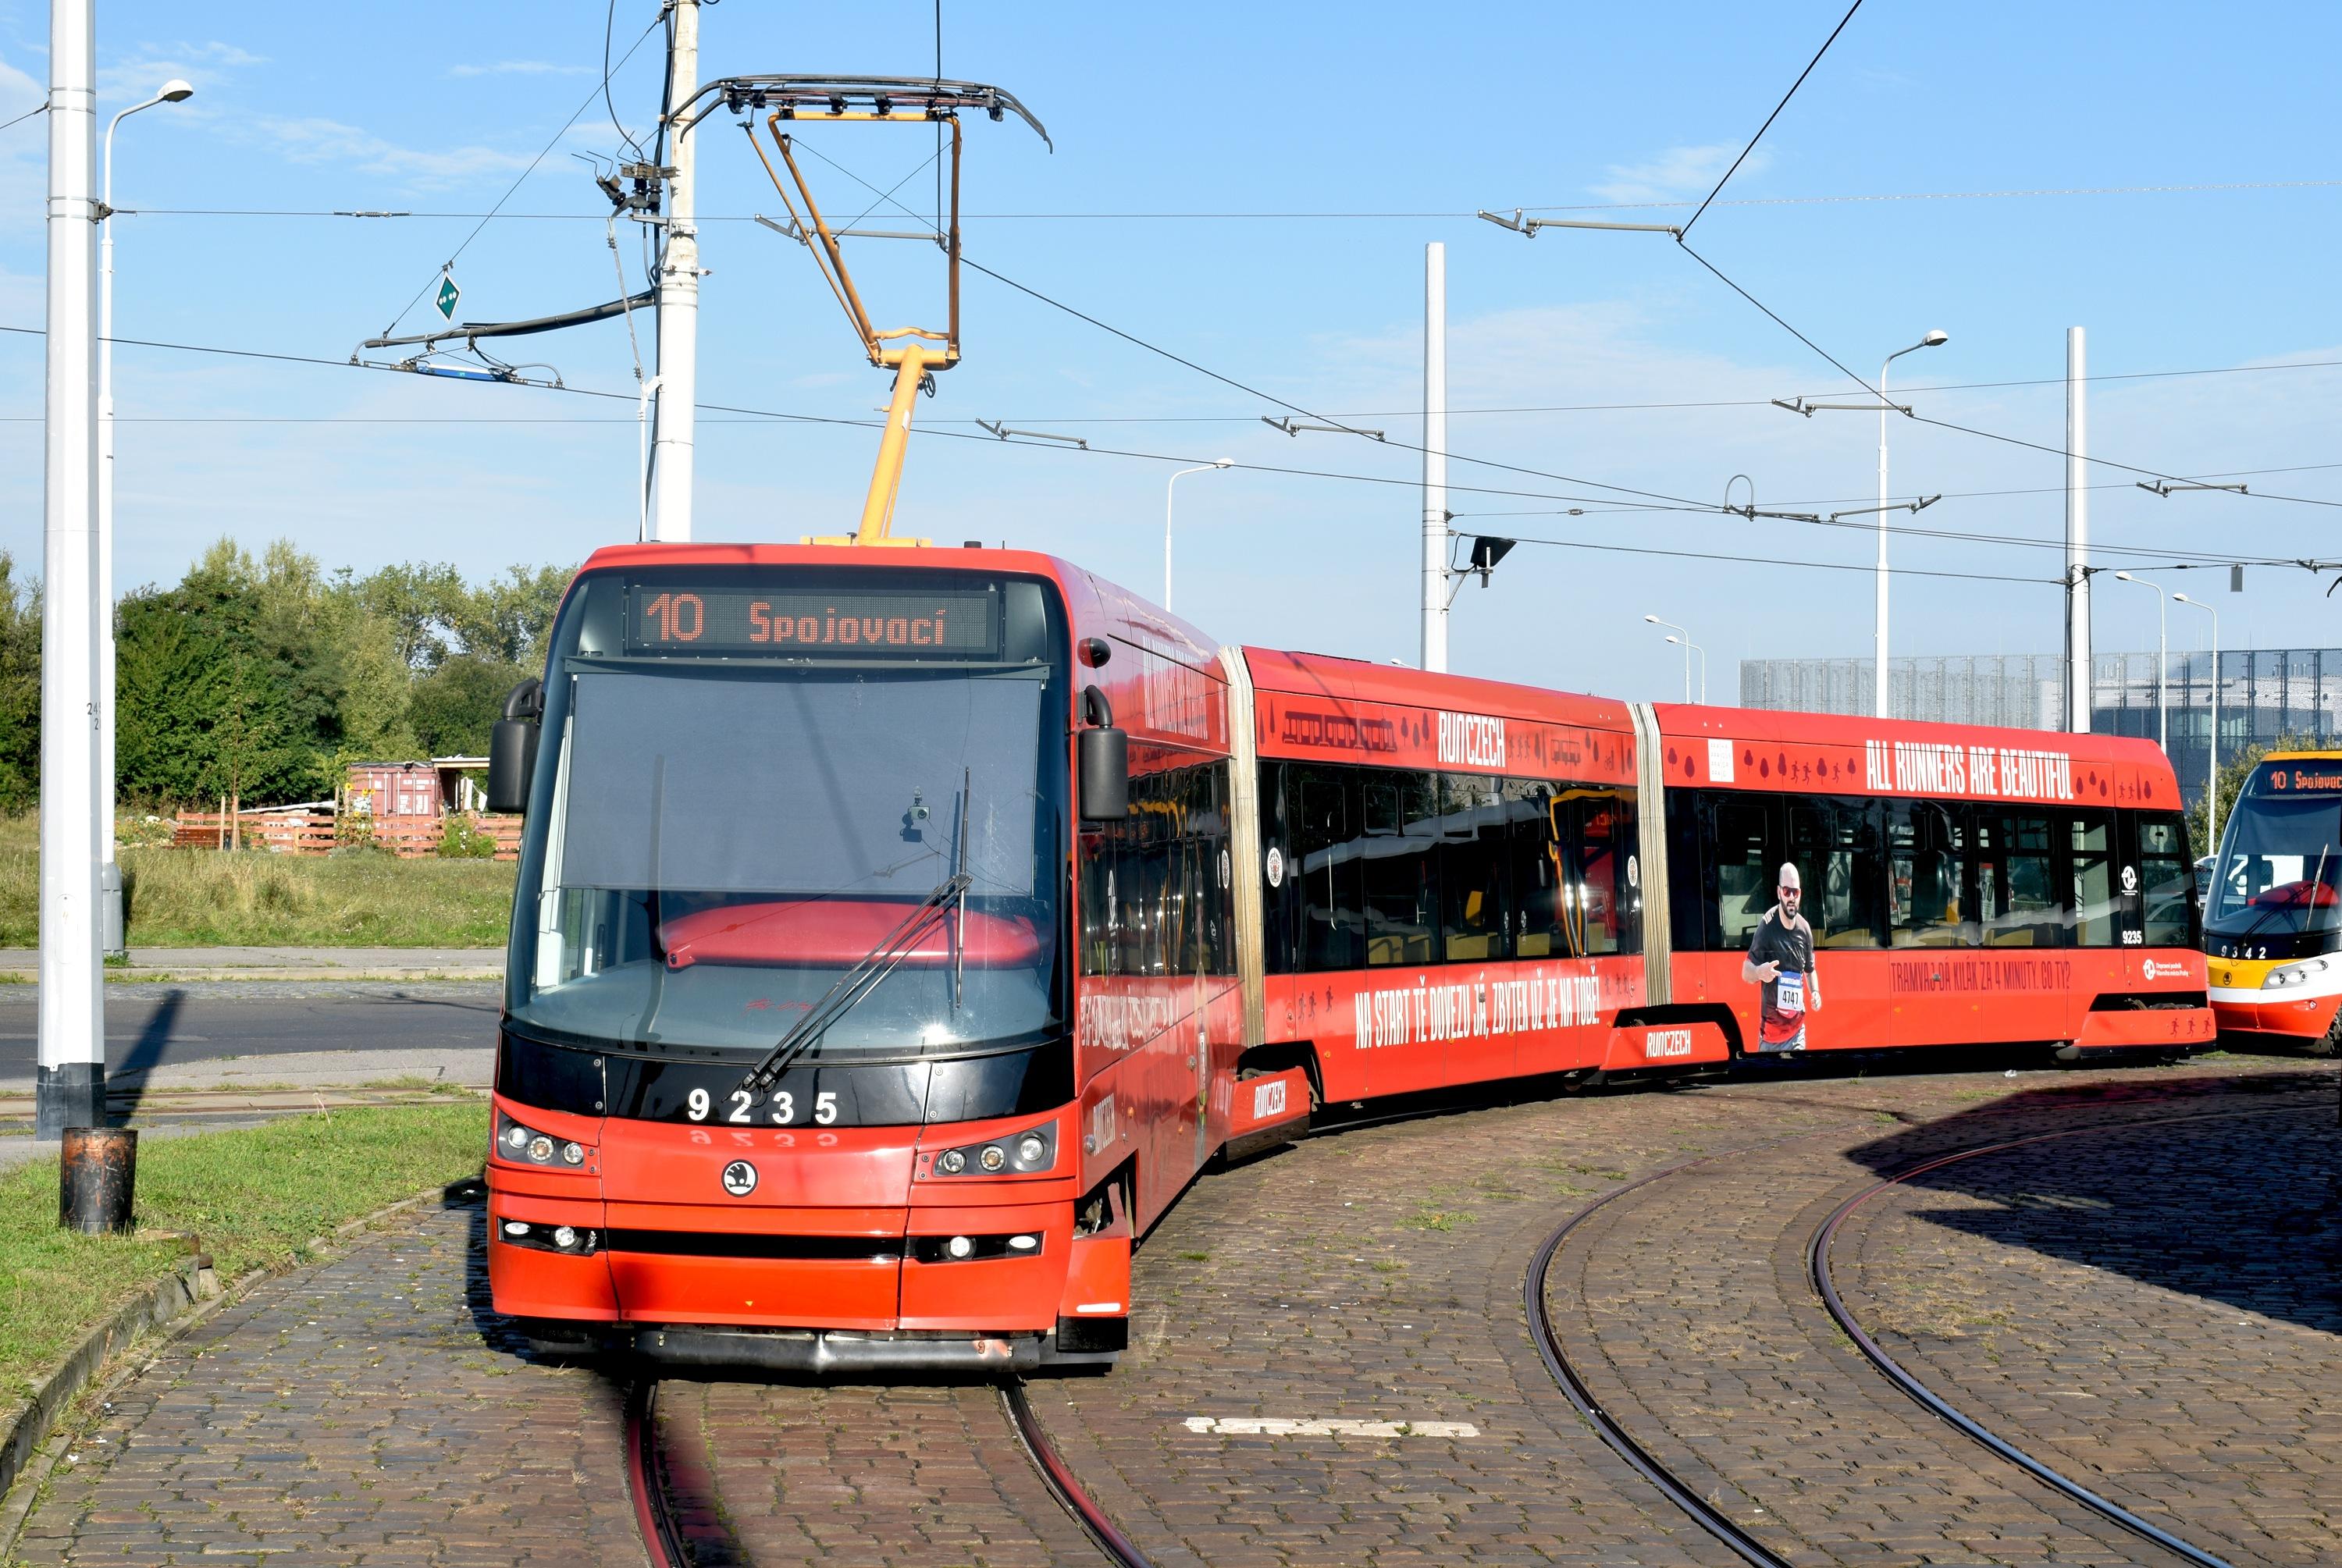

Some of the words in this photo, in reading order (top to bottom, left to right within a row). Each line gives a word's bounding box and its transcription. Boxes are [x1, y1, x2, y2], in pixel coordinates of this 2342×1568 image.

[647, 593, 703, 641] 10
[749, 602, 946, 645] Spojovací
[1439, 711, 1505, 768] RUNCZECH
[1866, 740, 1892, 791] ALL
[1895, 741, 1966, 794] RUNNERS
[1969, 746, 1998, 795] ARE
[2000, 748, 2073, 800] BEAUTIFUL
[2271, 771, 2287, 789] 10
[2123, 930, 2142, 944] 9235
[2221, 945, 2266, 959] 9342
[1891, 962, 1936, 992] TRAMVAJ
[1938, 955, 1952, 992] DÁ
[1953, 955, 1978, 992] KILÁK
[1980, 961, 1992, 990] ZA
[1995, 961, 2001, 990] 4
[2041, 961, 2053, 990] CO
[2055, 961, 2071, 990] TY?
[1354, 992, 1372, 1049] NA
[1374, 989, 1411, 1047] START
[1413, 975, 1427, 1043] TĚ
[1429, 984, 1471, 1041] DOVEZU
[1492, 980, 1529, 1034] ZBYTEK
[1530, 968, 1543, 1030] UŽ
[1547, 979, 1557, 1029] JE
[1560, 976, 1572, 1027] NA
[1574, 965, 1600, 1026] TOBĚ!
[1782, 990, 1799, 1006] 4747
[1646, 1029, 1691, 1058] RUNCZECH
[688, 1088, 838, 1125] 9235
[1254, 1079, 1286, 1120] RUNCZECH
